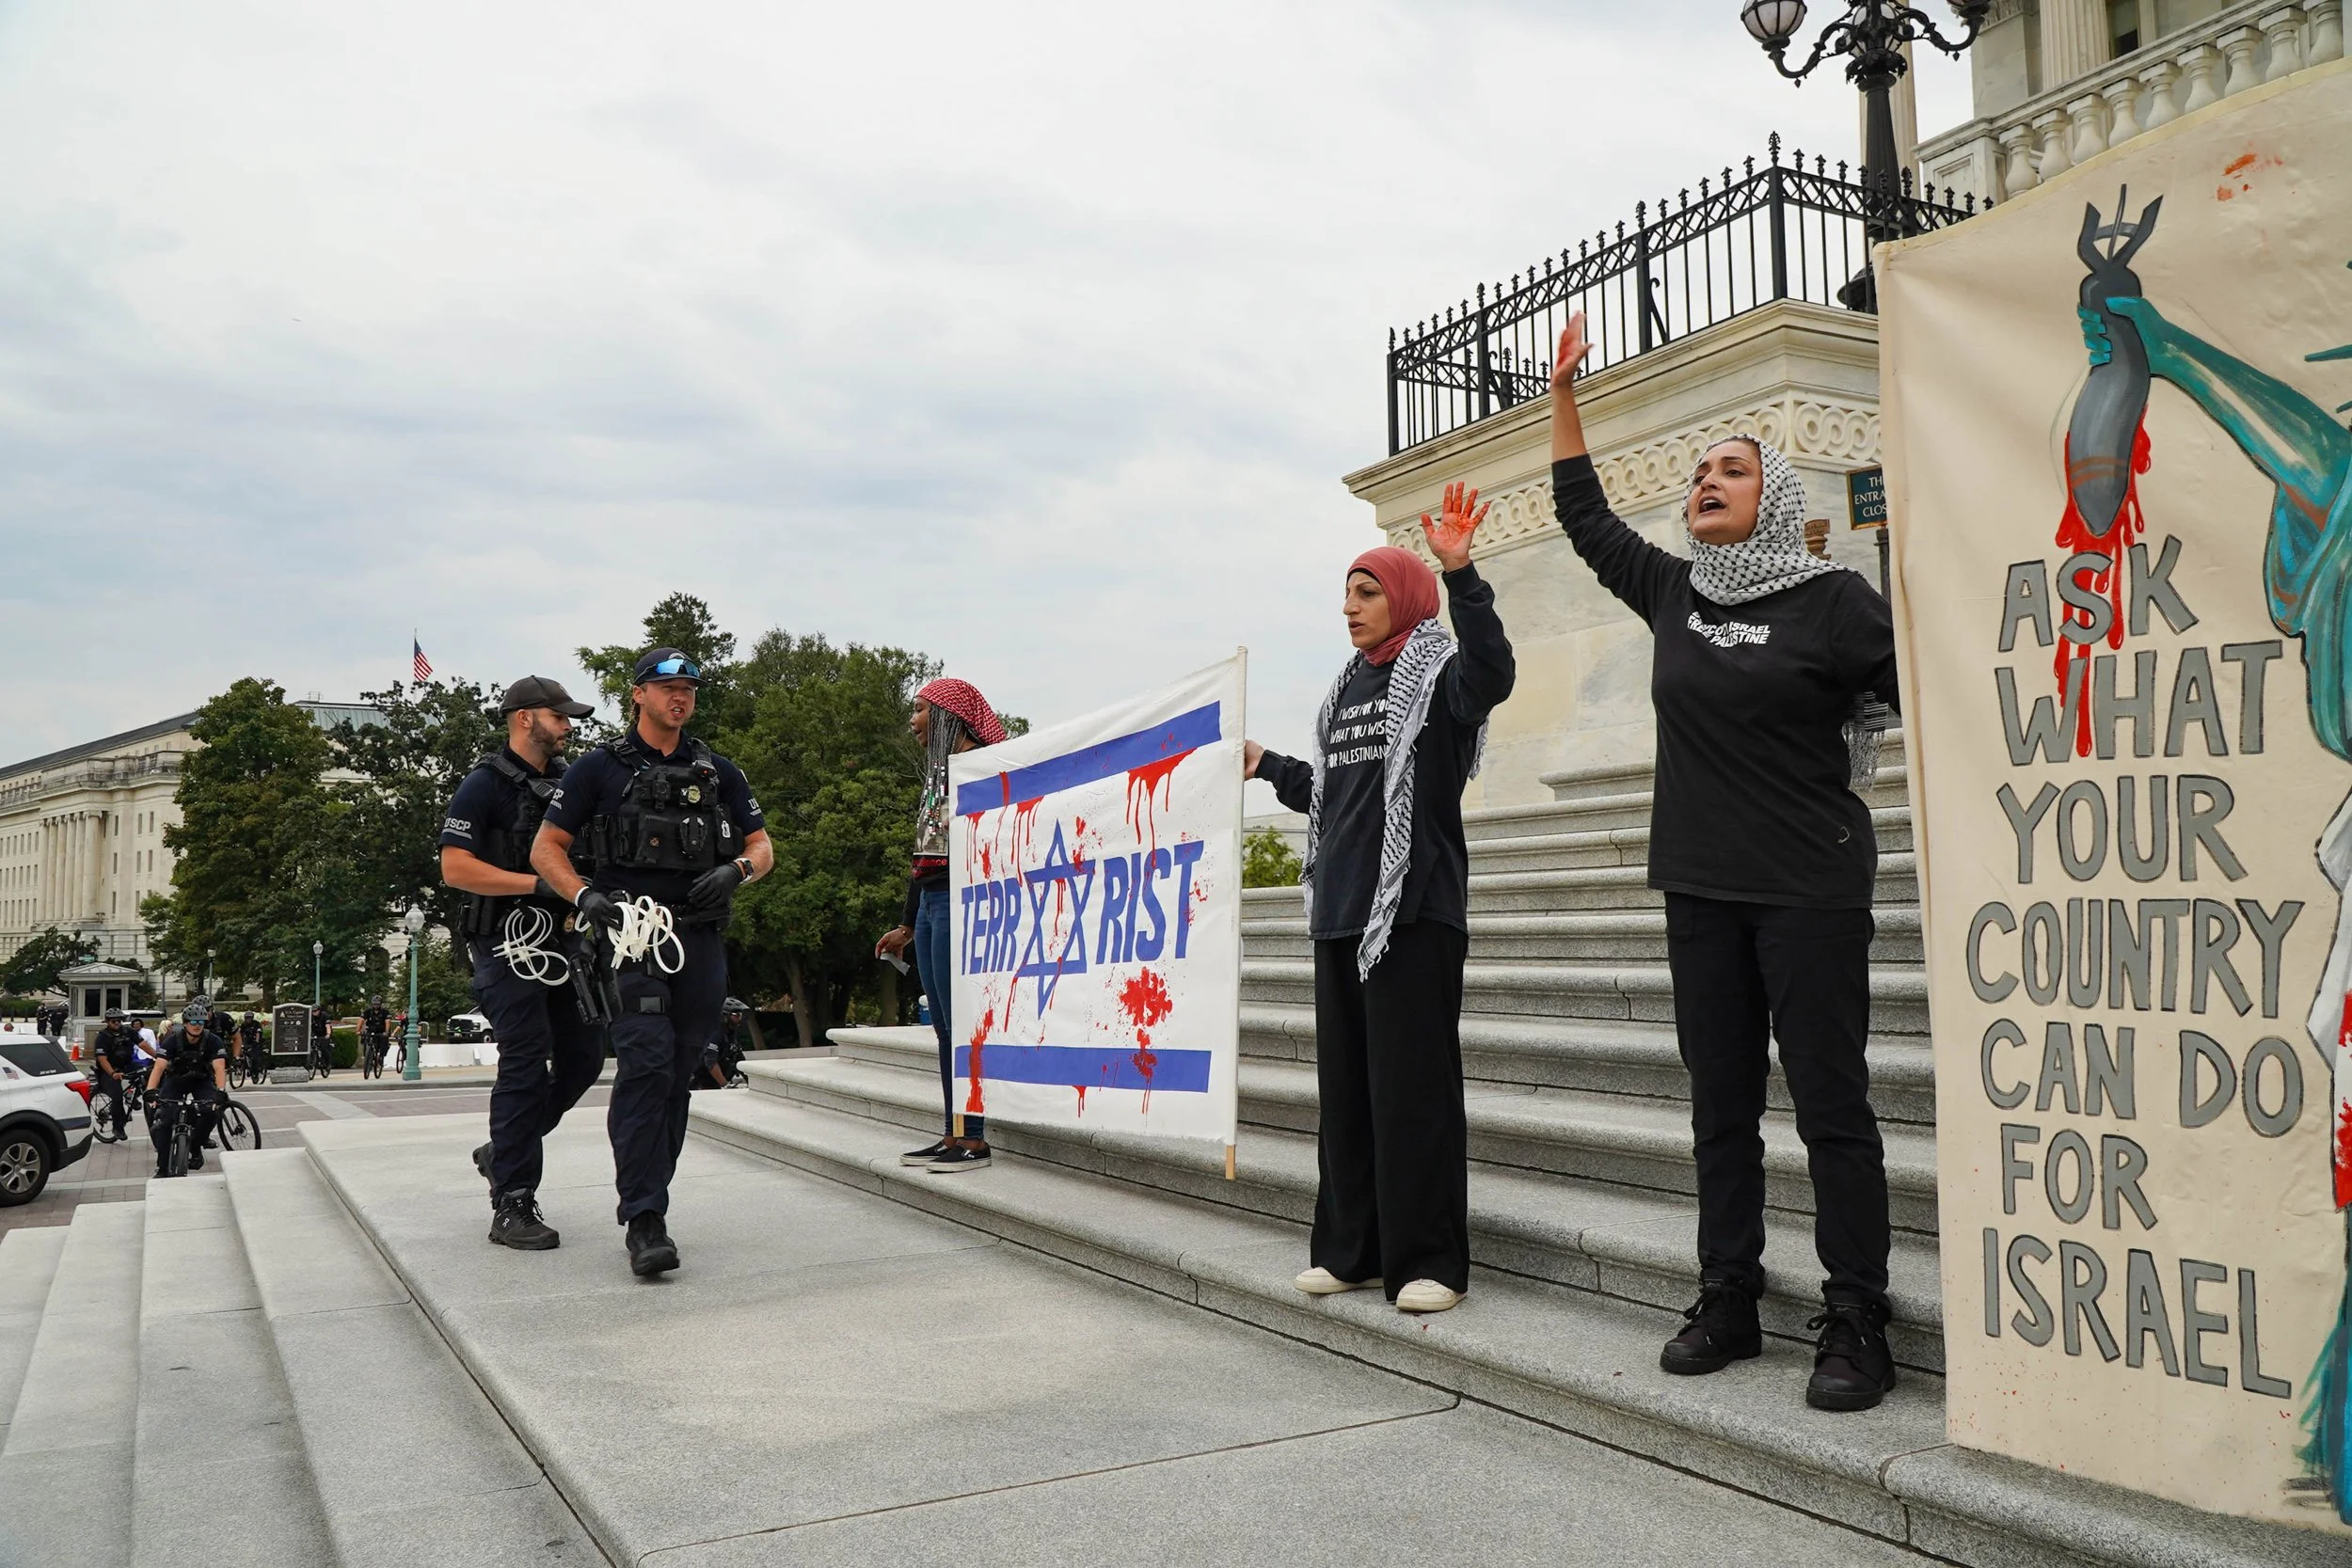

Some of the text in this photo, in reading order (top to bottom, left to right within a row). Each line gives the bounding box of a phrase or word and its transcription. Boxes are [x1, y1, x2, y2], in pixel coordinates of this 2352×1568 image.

[1867, 475, 1883, 487] TH
[1854, 490, 1885, 505] ENTRA
[1863, 504, 1887, 517] CLOS
[1998, 534, 2200, 653] ASK
[1729, 621, 1771, 634] ISRAEL
[1342, 705, 1361, 721] WISH
[1994, 639, 2283, 767] WHAT
[1329, 720, 1386, 744] WHAT YOU WIS
[1327, 744, 1387, 768] FOR PALESTINIAN
[444, 817, 472, 832] USCP
[1995, 774, 2249, 884] YOUR
[1966, 897, 2306, 1019] COUNTRY
[1980, 1018, 2304, 1138] CAN DO
[2000, 1122, 2158, 1231] FOR
[1982, 1227, 2292, 1400] ISRAEL
